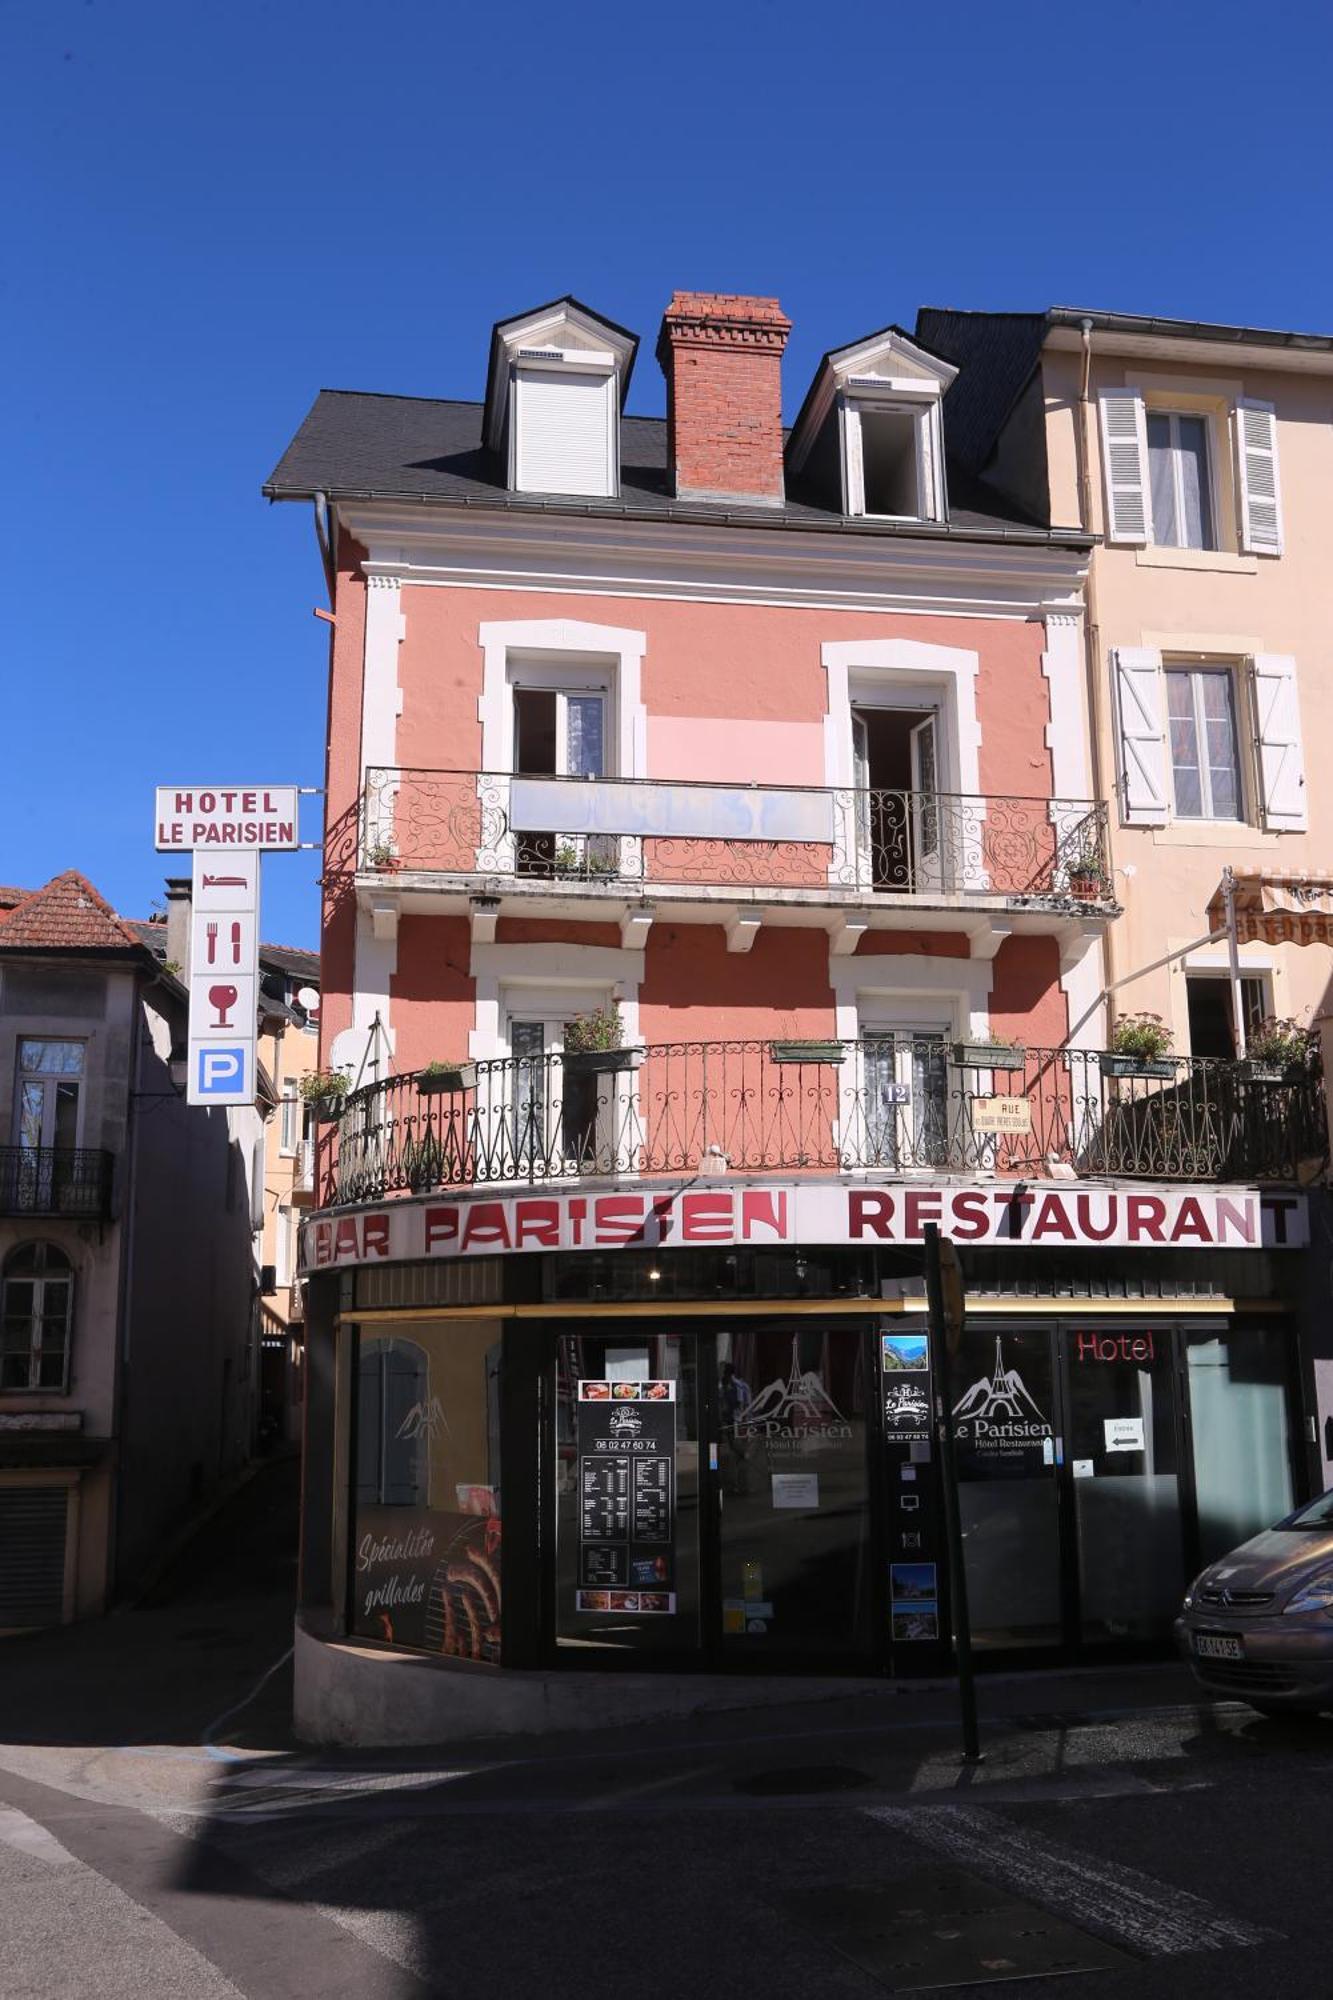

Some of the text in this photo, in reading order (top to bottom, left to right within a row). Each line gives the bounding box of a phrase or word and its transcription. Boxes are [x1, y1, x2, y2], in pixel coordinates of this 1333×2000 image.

[175, 792, 278, 814] HOTEL
[159, 822, 293, 844] LE PARISIEN
[203, 1054, 239, 1089] P
[886, 1086, 907, 1103] 12
[1001, 1104, 1021, 1114] RUE
[316, 1214, 391, 1266] BAR
[425, 1190, 787, 1254] PARISIEN
[848, 1190, 1298, 1244] RESTAURANT
[1077, 1330, 1155, 1361] Hotel
[734, 1421, 853, 1439] Le Parisien
[954, 1420, 1053, 1439] e Parisien
[608, 1440, 619, 1449] 02
[620, 1440, 631, 1449] 47
[645, 1440, 656, 1450] 74
[357, 1528, 435, 1571] Spécialités
[364, 1573, 426, 1616] grillades
